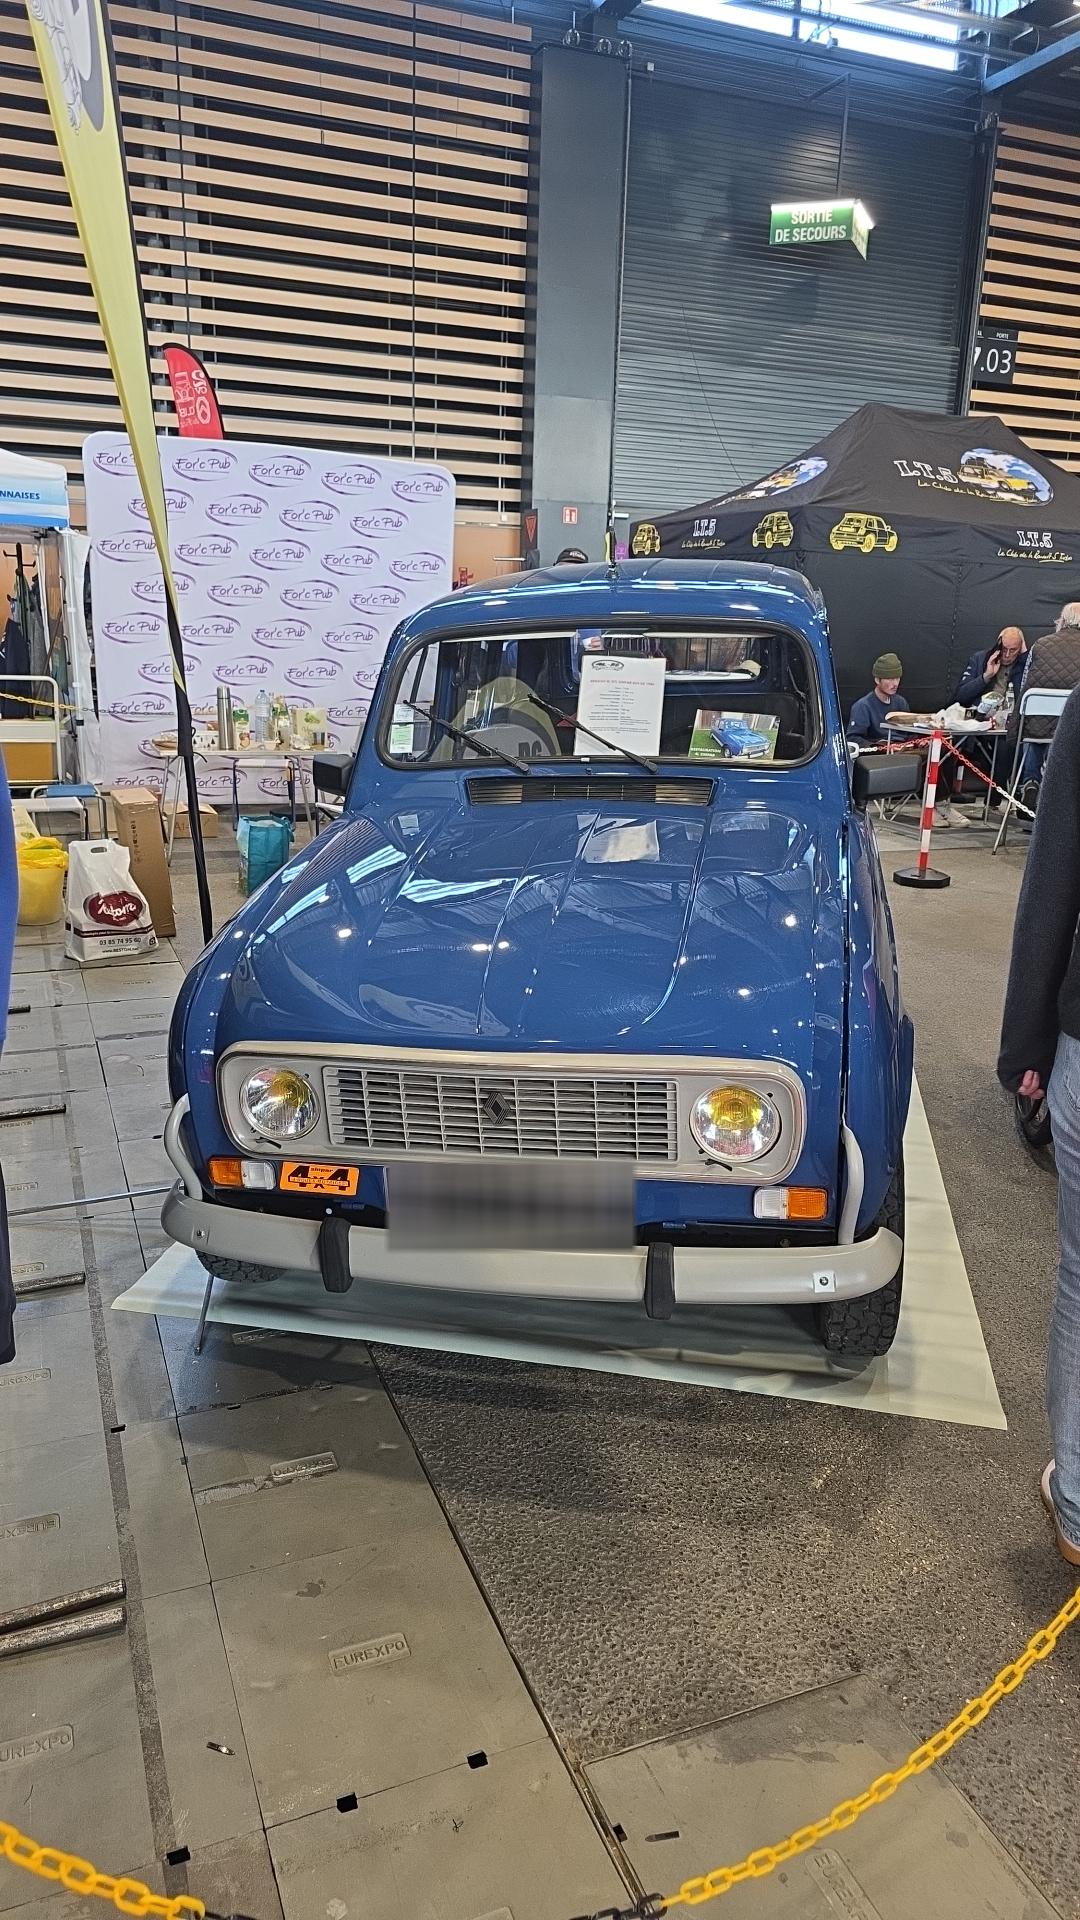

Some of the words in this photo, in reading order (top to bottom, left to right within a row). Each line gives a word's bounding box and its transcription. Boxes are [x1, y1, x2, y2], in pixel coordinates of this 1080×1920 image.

[791, 208, 833, 224] SORTIE
[775, 229, 790, 242] DE
[792, 225, 847, 242] SECOURS
[206, 457, 231, 469] Pub
[283, 464, 305, 476] Pub
[354, 473, 375, 484] Pub
[423, 481, 444, 492] Pub
[166, 497, 186, 508] Pub
[240, 502, 262, 514] Pub
[312, 509, 334, 520] Pub
[382, 517, 403, 528] Pub
[132, 539, 156, 550] Pub
[209, 542, 231, 554] Pub
[282, 547, 304, 559] Pub
[352, 554, 373, 565] Pub
[419, 561, 440, 571] Pub
[241, 584, 263, 594] Pub
[313, 588, 333, 598] Pub
[379, 594, 400, 604] Pub
[137, 621, 160, 632] Pub
[212, 624, 234, 634] Pub
[284, 627, 305, 637] Pub
[352, 631, 373, 641] Pub
[246, 664, 268, 674] Pub
[316, 666, 337, 677] Pub
[142, 701, 165, 711] Pub
[334, 1640, 405, 1669] EUREXPO
